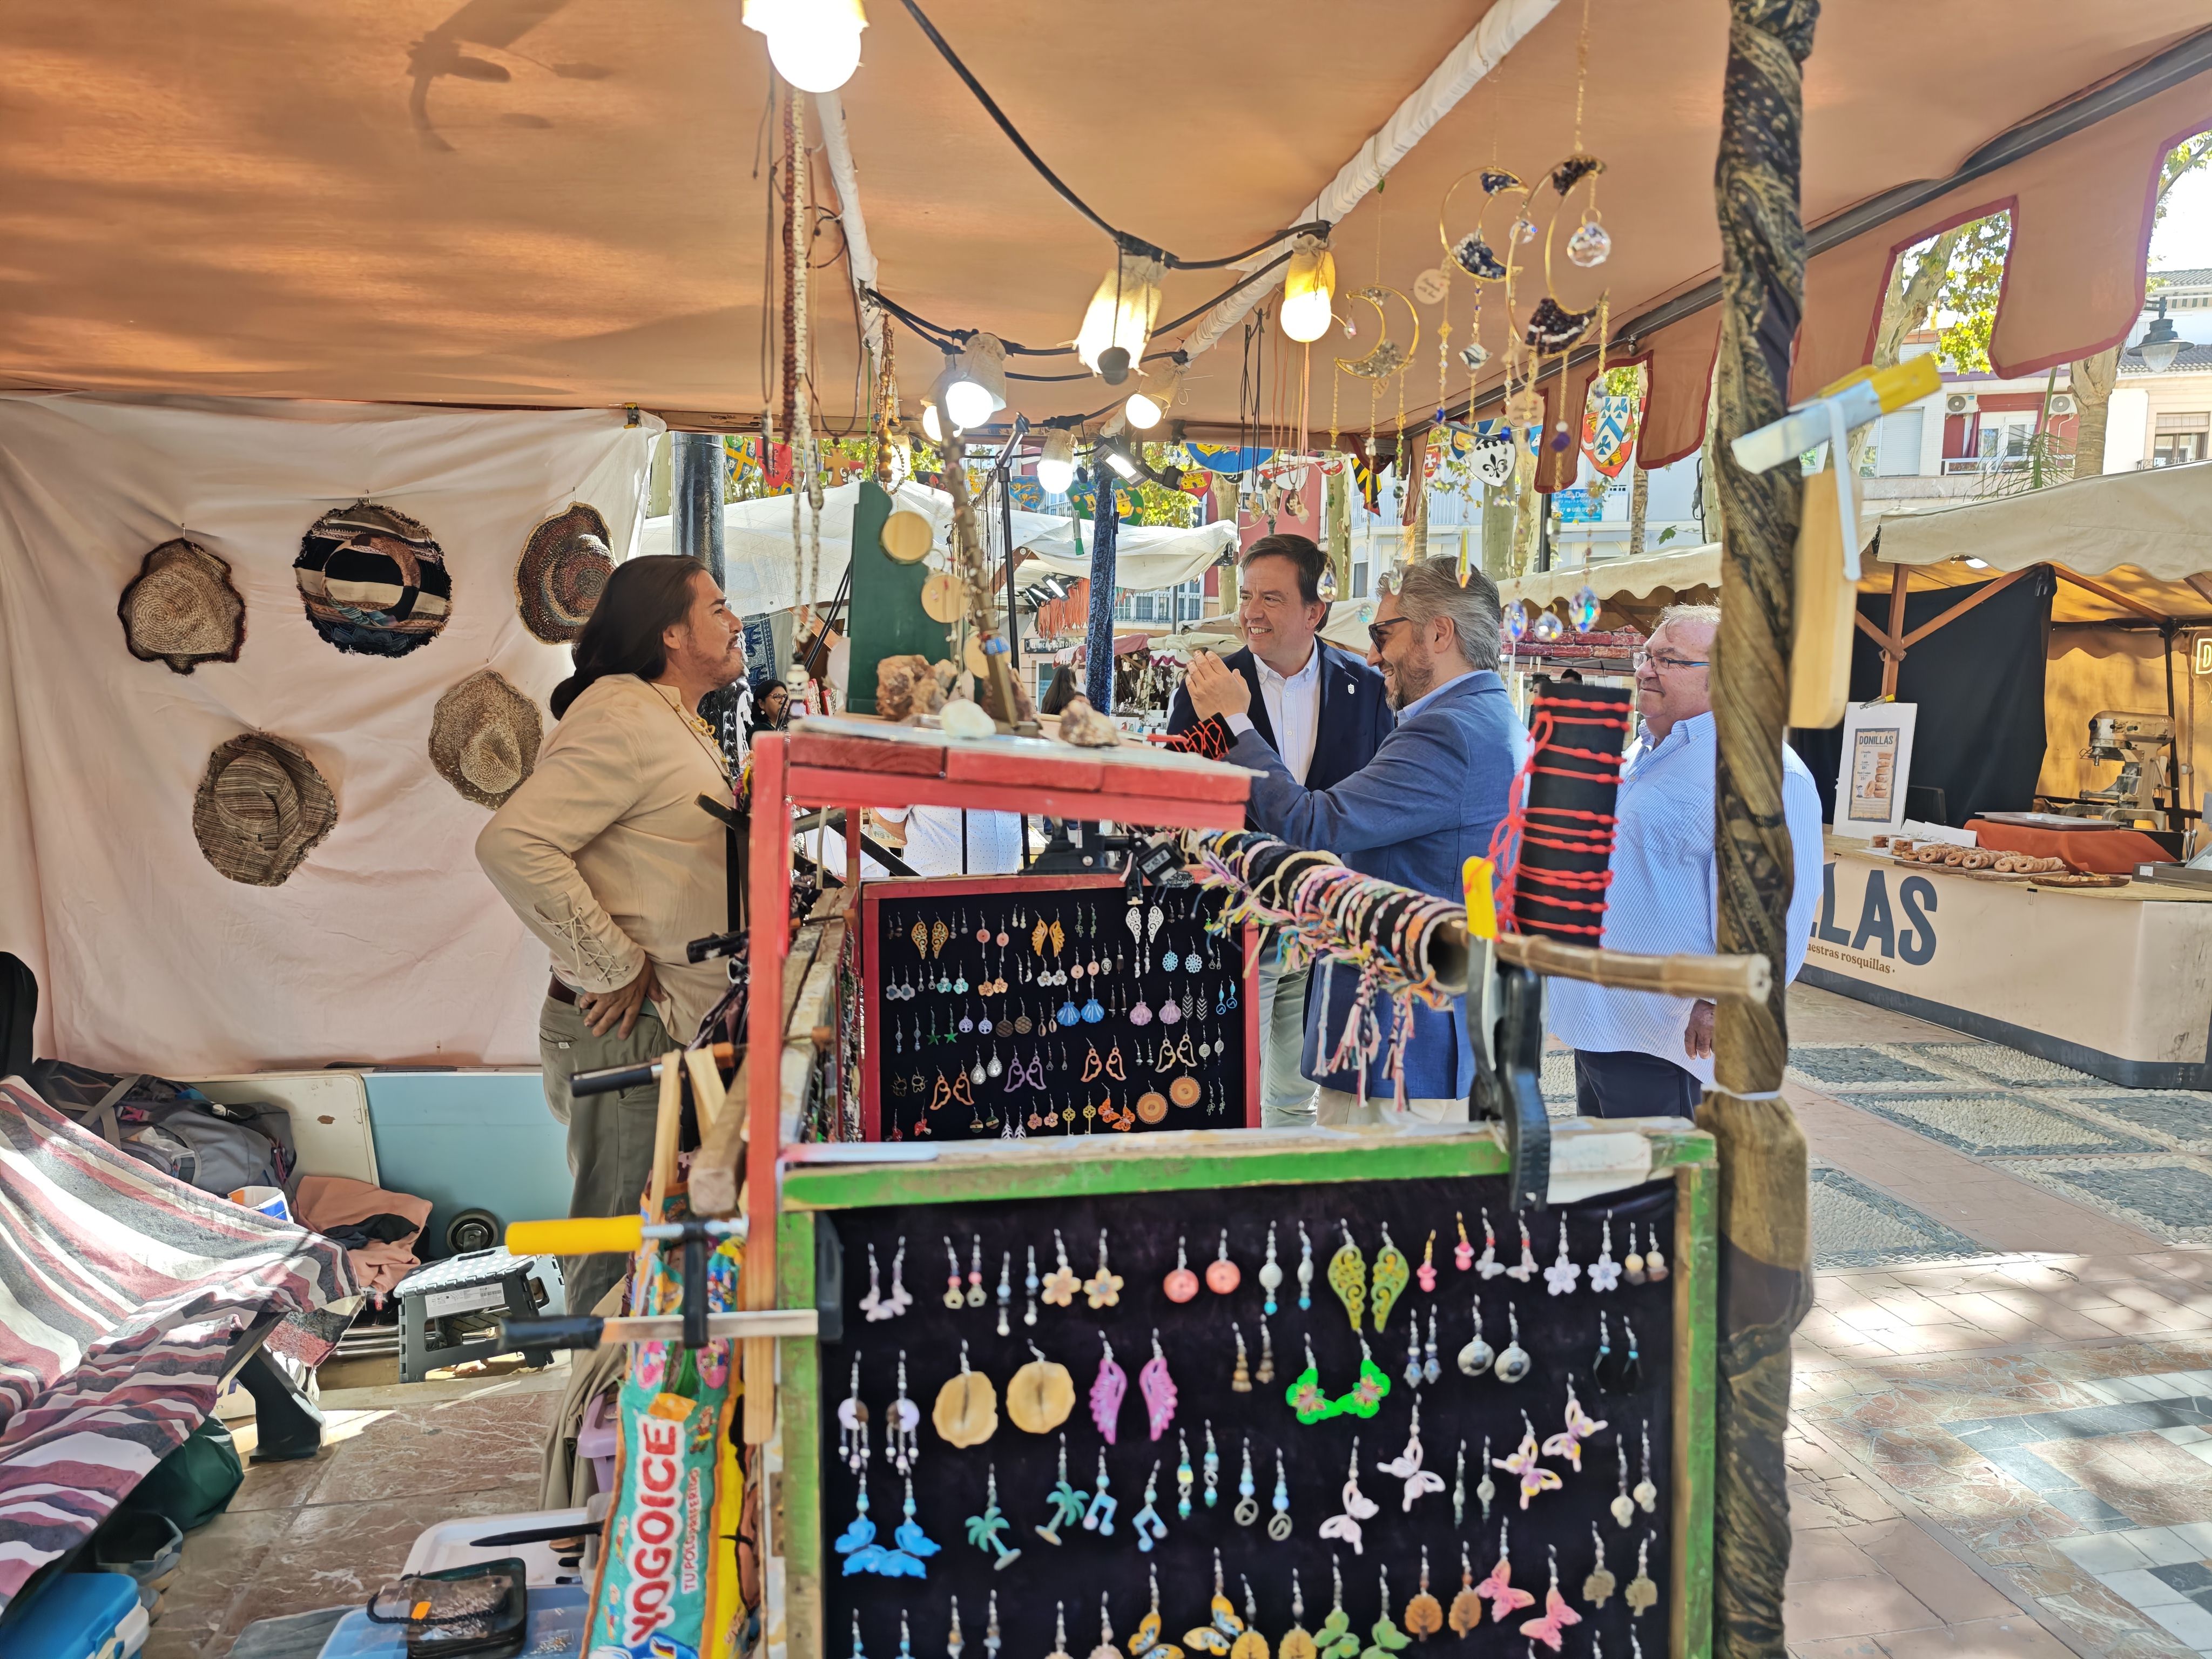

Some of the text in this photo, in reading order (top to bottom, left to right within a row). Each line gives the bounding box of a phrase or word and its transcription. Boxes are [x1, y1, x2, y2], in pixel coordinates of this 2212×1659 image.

[1859, 735, 1893, 745] DONILLAS
[1810, 862, 1938, 966] LAS
[1841, 952, 1891, 974] rosquillas
